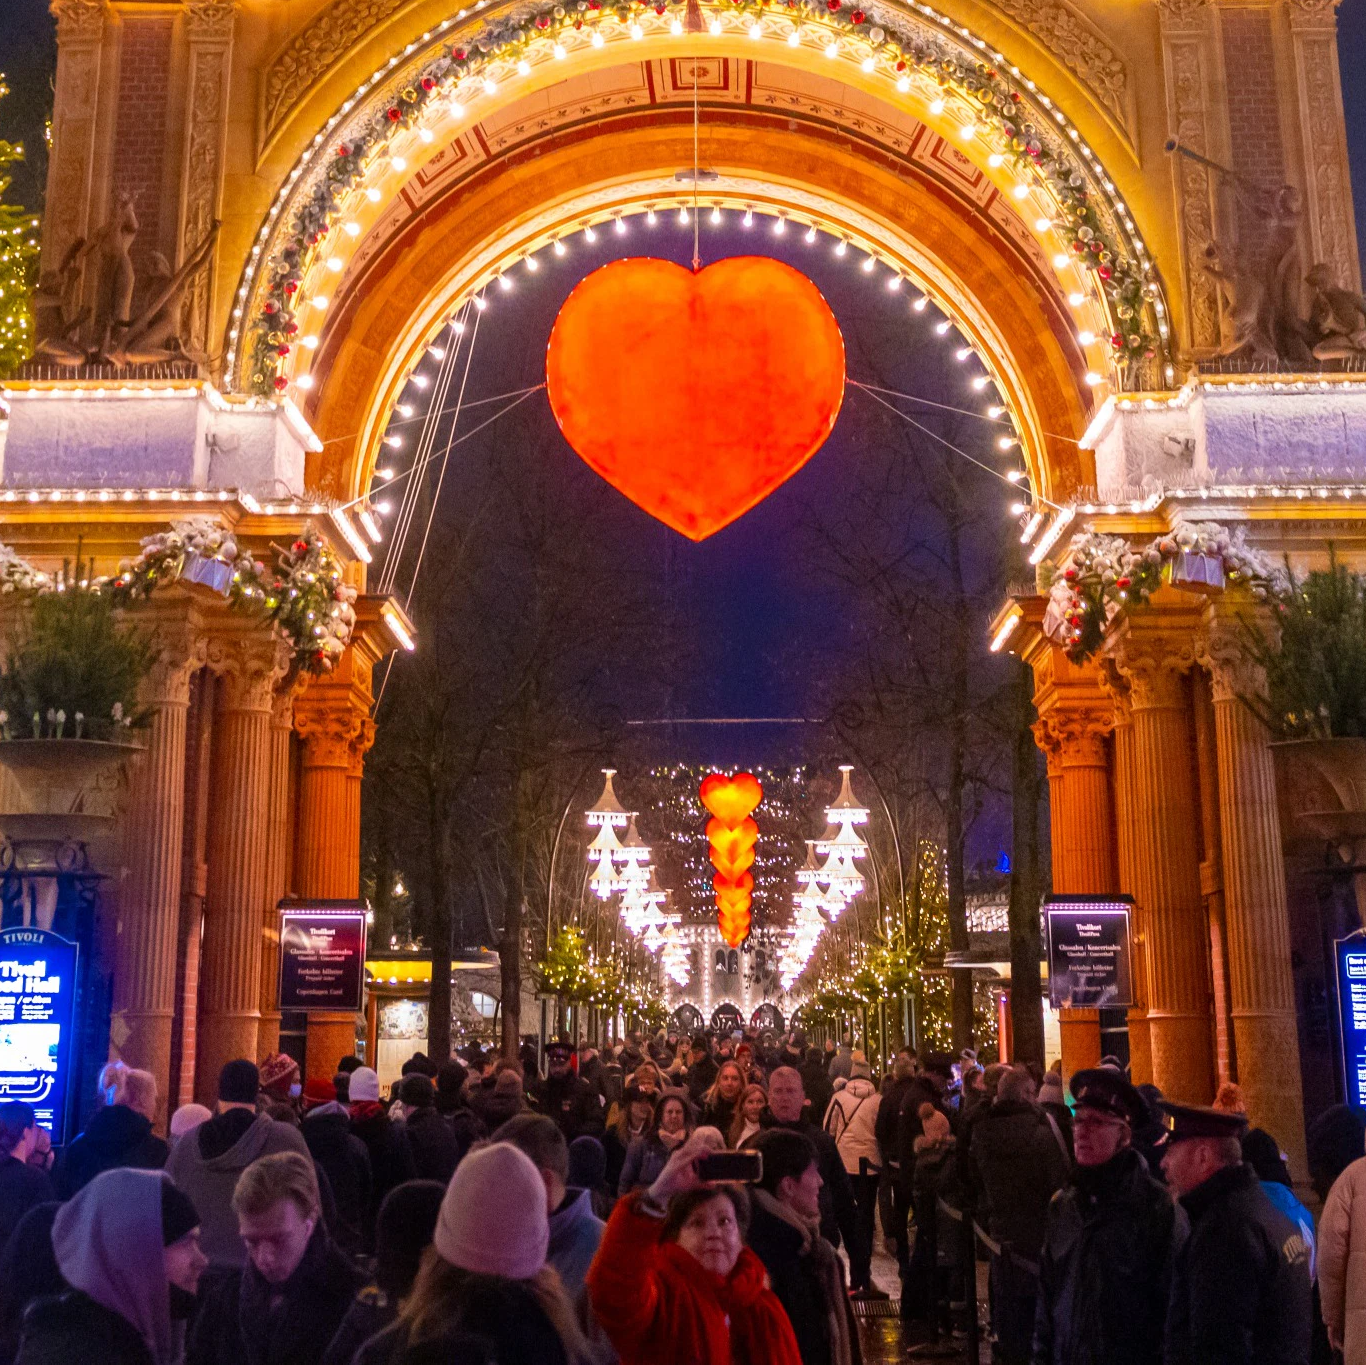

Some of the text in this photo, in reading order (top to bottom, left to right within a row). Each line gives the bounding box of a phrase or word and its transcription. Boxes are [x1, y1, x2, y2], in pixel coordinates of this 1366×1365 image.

[3, 932, 45, 944] TIVOLI
[0, 961, 46, 977] Tivoli
[25, 976, 60, 993] Hall
